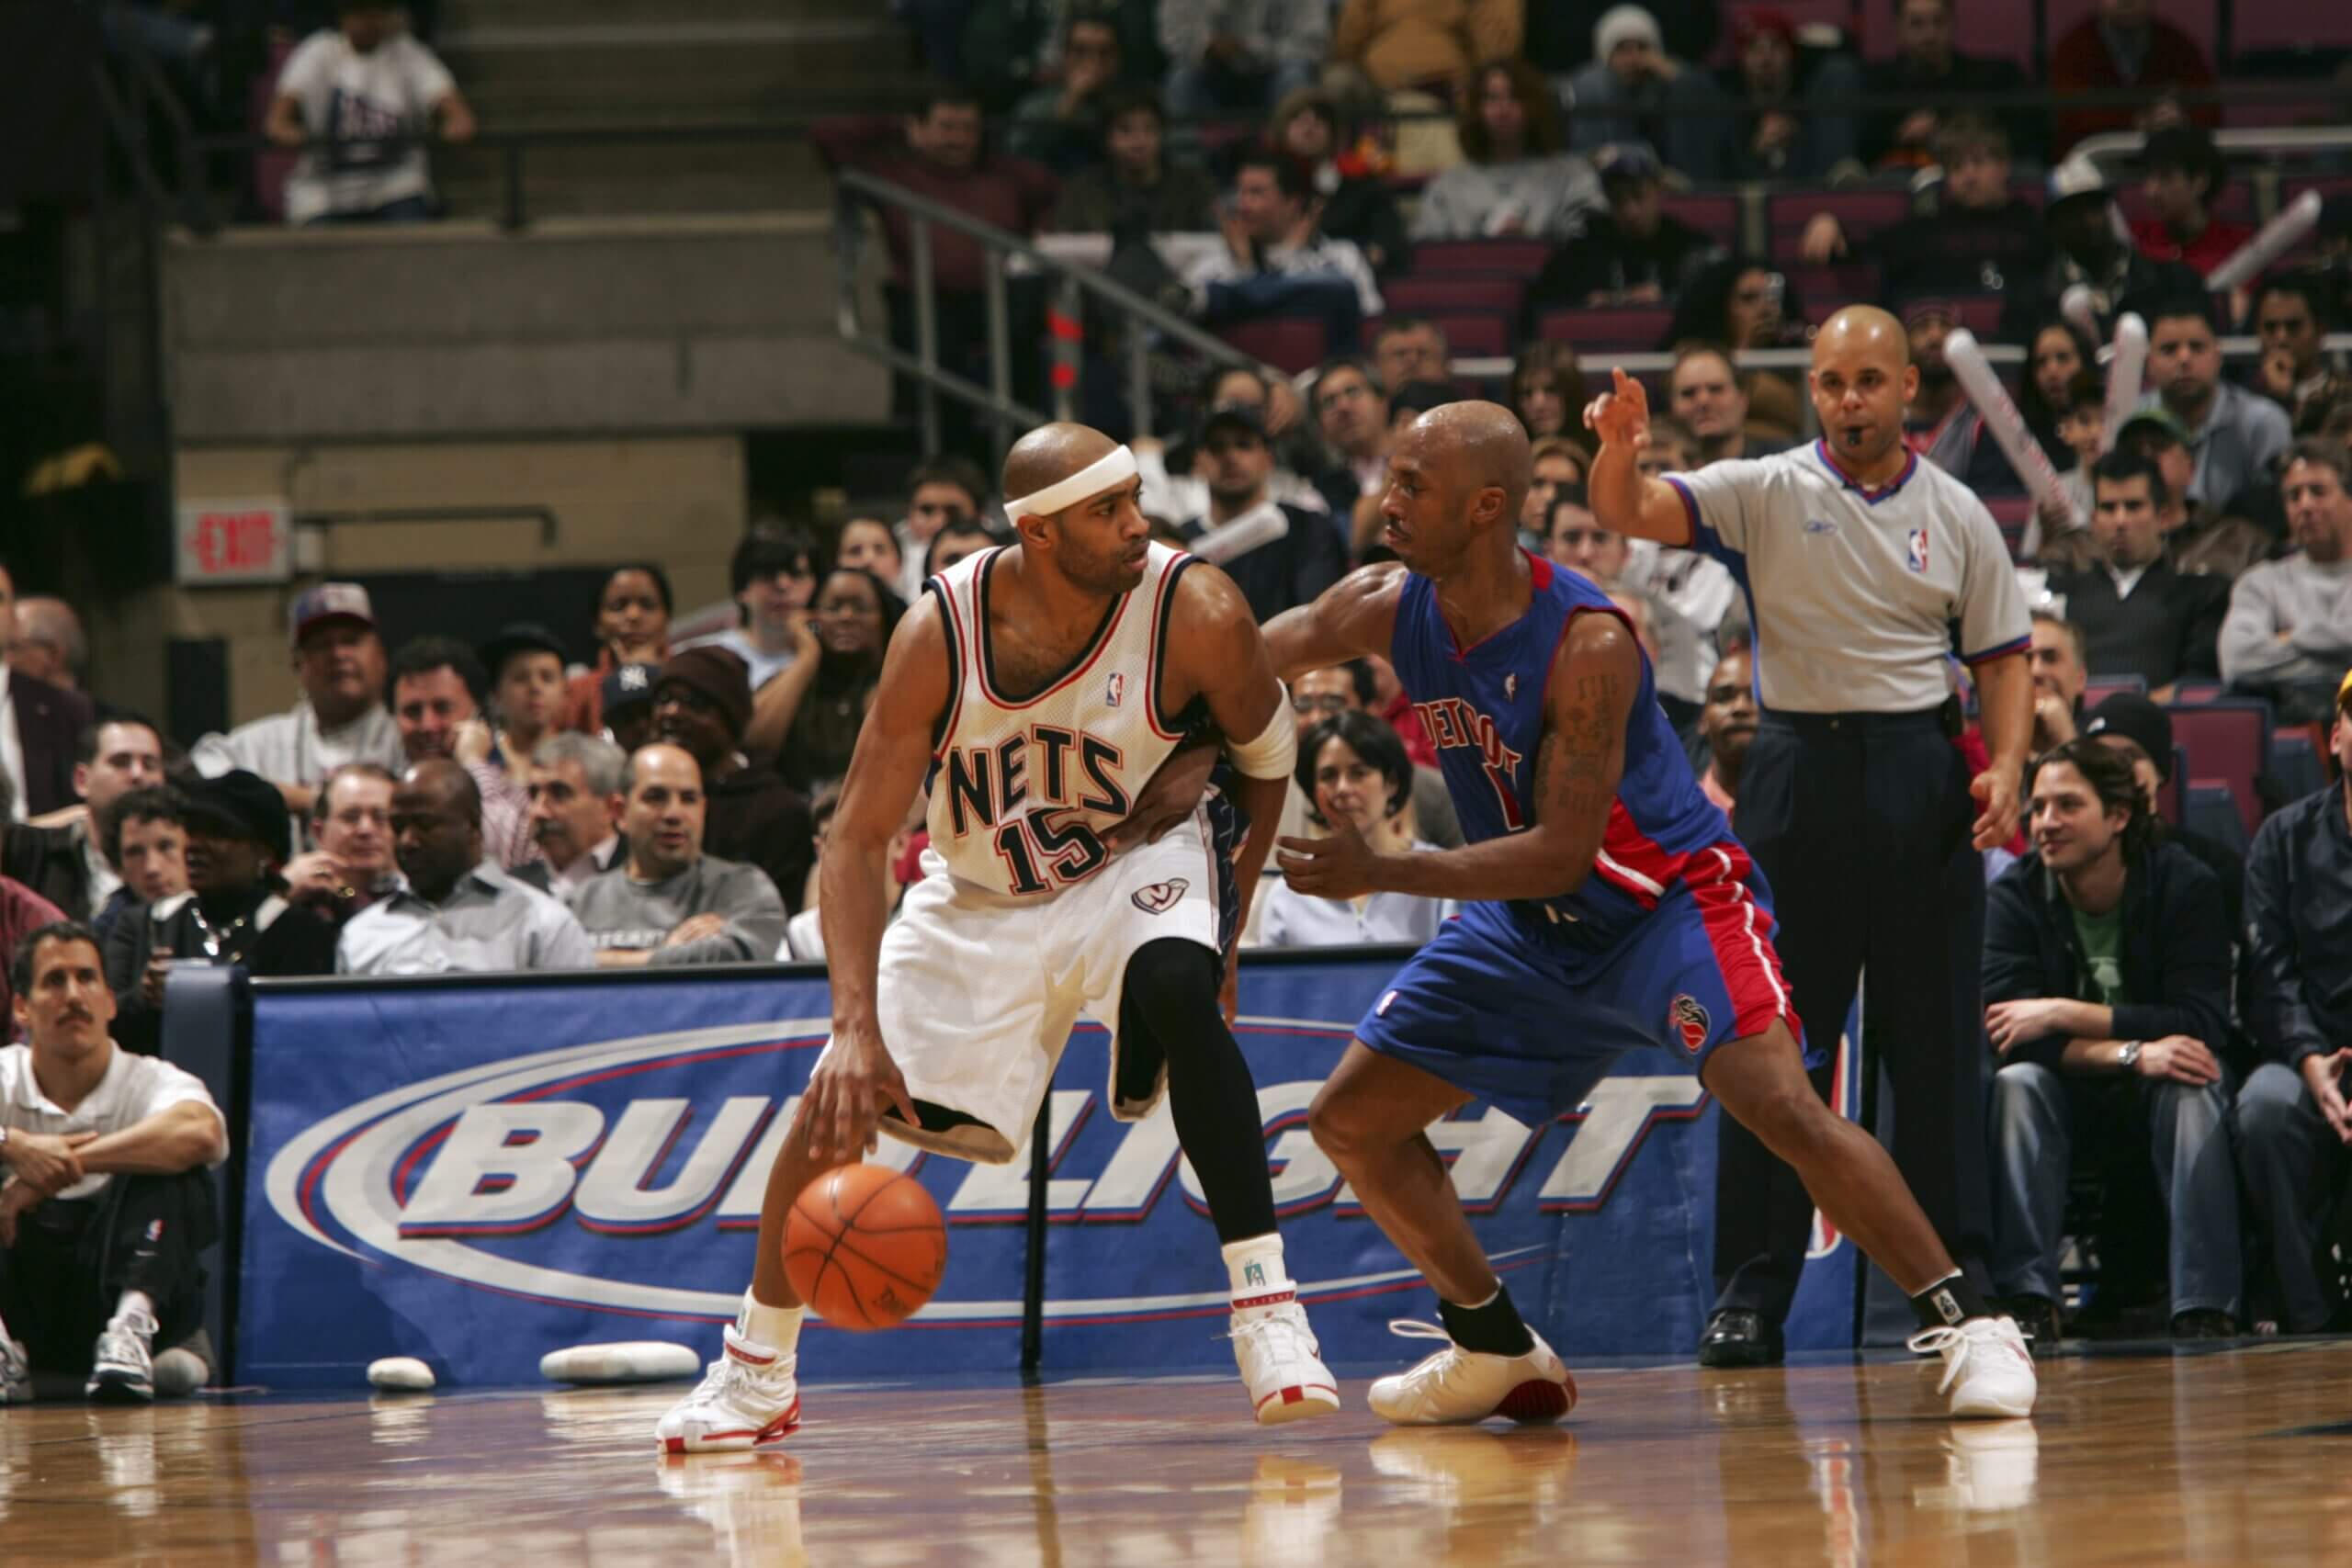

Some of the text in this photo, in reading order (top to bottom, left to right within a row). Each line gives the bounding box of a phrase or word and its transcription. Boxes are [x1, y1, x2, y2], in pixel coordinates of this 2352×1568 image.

[198, 512, 273, 572] EXIT
[947, 724, 1131, 838] NETS
[1411, 697, 1522, 788] DETROT
[994, 807, 1109, 896] 15
